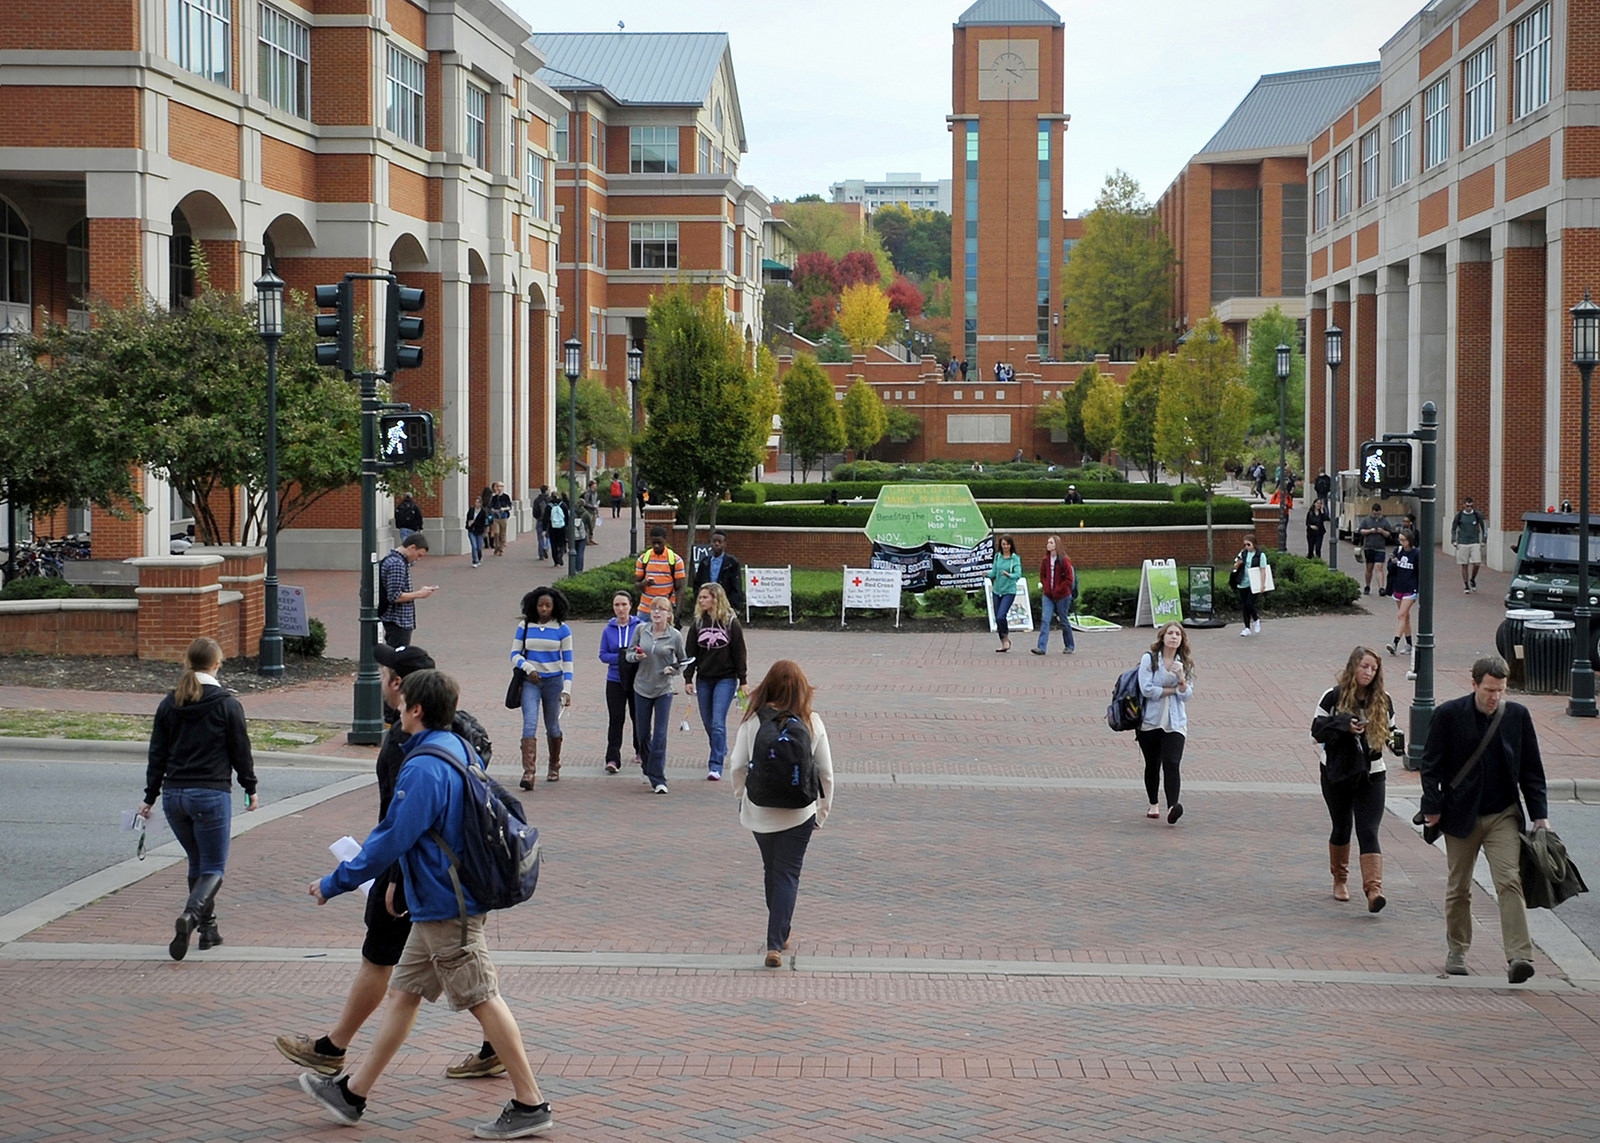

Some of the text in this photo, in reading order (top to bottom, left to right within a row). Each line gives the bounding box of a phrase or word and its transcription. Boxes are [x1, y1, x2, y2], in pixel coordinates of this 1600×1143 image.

[930, 507, 955, 515] Levne
[912, 511, 925, 520] The
[927, 521, 958, 529] Hosptal
